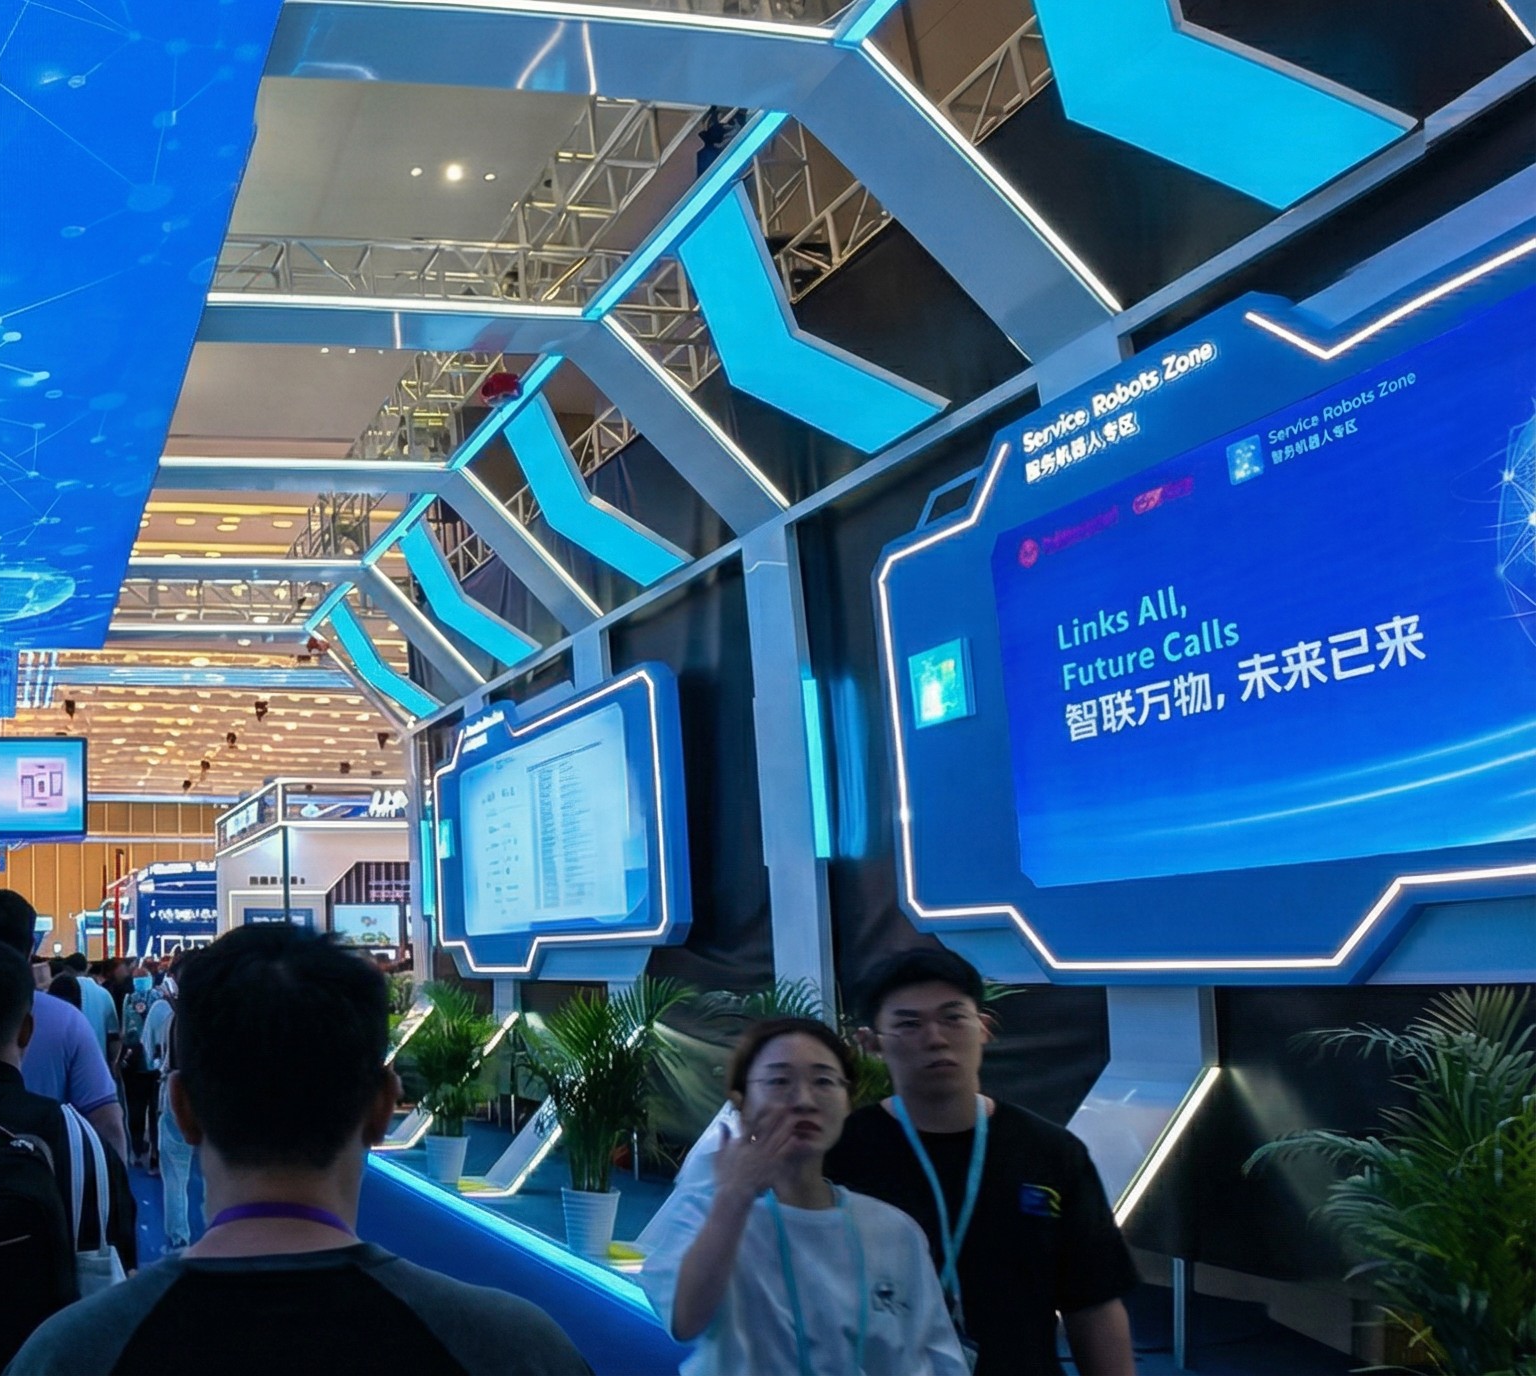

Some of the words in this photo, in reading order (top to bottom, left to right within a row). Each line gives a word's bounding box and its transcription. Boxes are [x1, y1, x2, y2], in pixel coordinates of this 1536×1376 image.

[1022, 409, 1088, 453] Service
[1091, 370, 1161, 418] Robots
[1161, 343, 1214, 380] Zone
[1267, 415, 1319, 445] Service
[1323, 390, 1375, 422] Robots
[1377, 372, 1416, 398] Zone
[1056, 608, 1130, 651] Links
[1137, 585, 1188, 626] All,
[1062, 644, 1156, 691] Future
[1162, 618, 1240, 662] Calls
